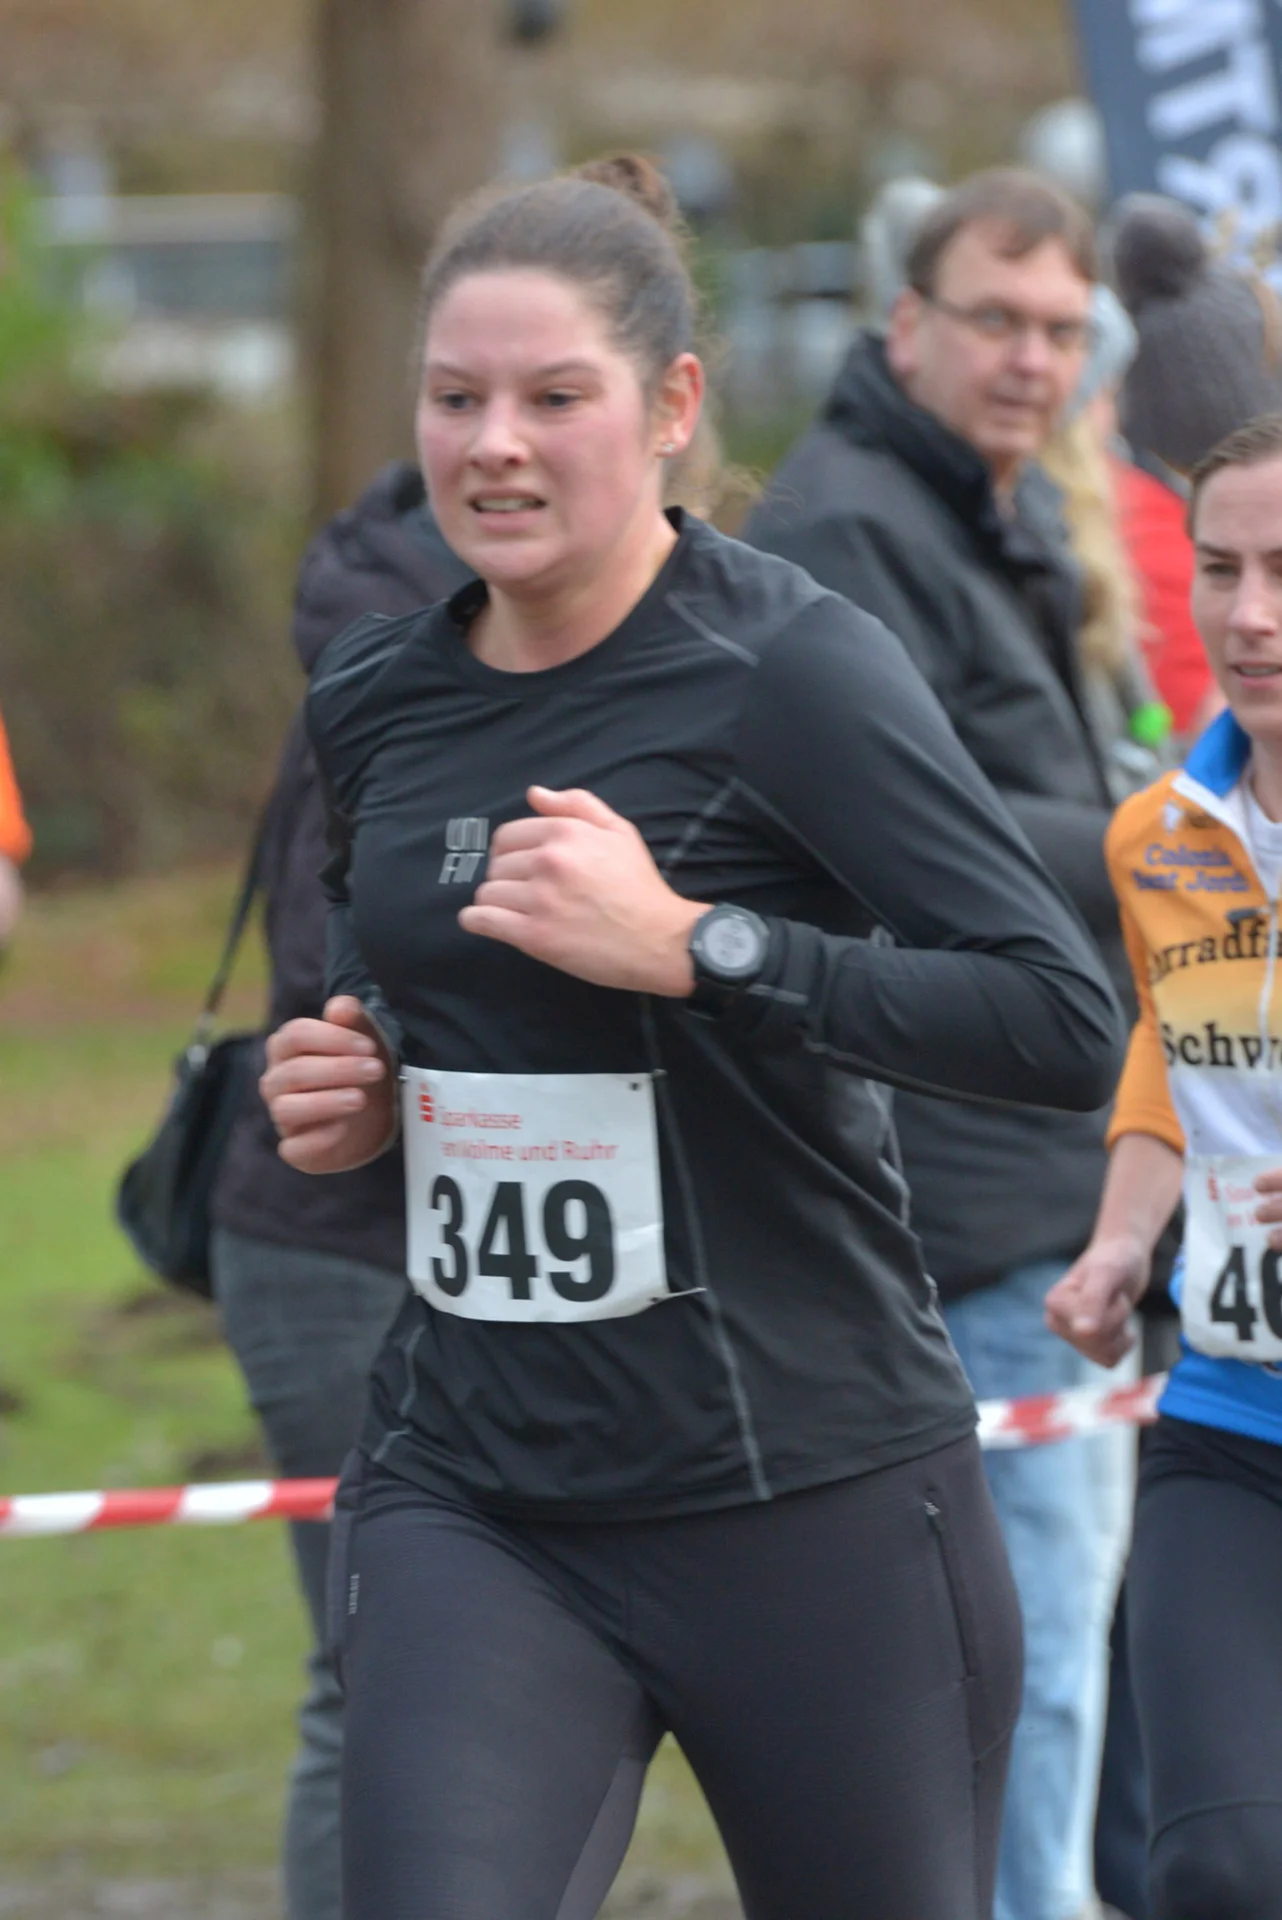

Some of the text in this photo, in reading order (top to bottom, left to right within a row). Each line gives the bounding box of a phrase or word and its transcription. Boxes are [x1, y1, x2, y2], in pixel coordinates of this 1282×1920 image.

[518, 1140, 557, 1161] und
[561, 1139, 619, 1161] Ruhr
[430, 1174, 616, 1303] 349
